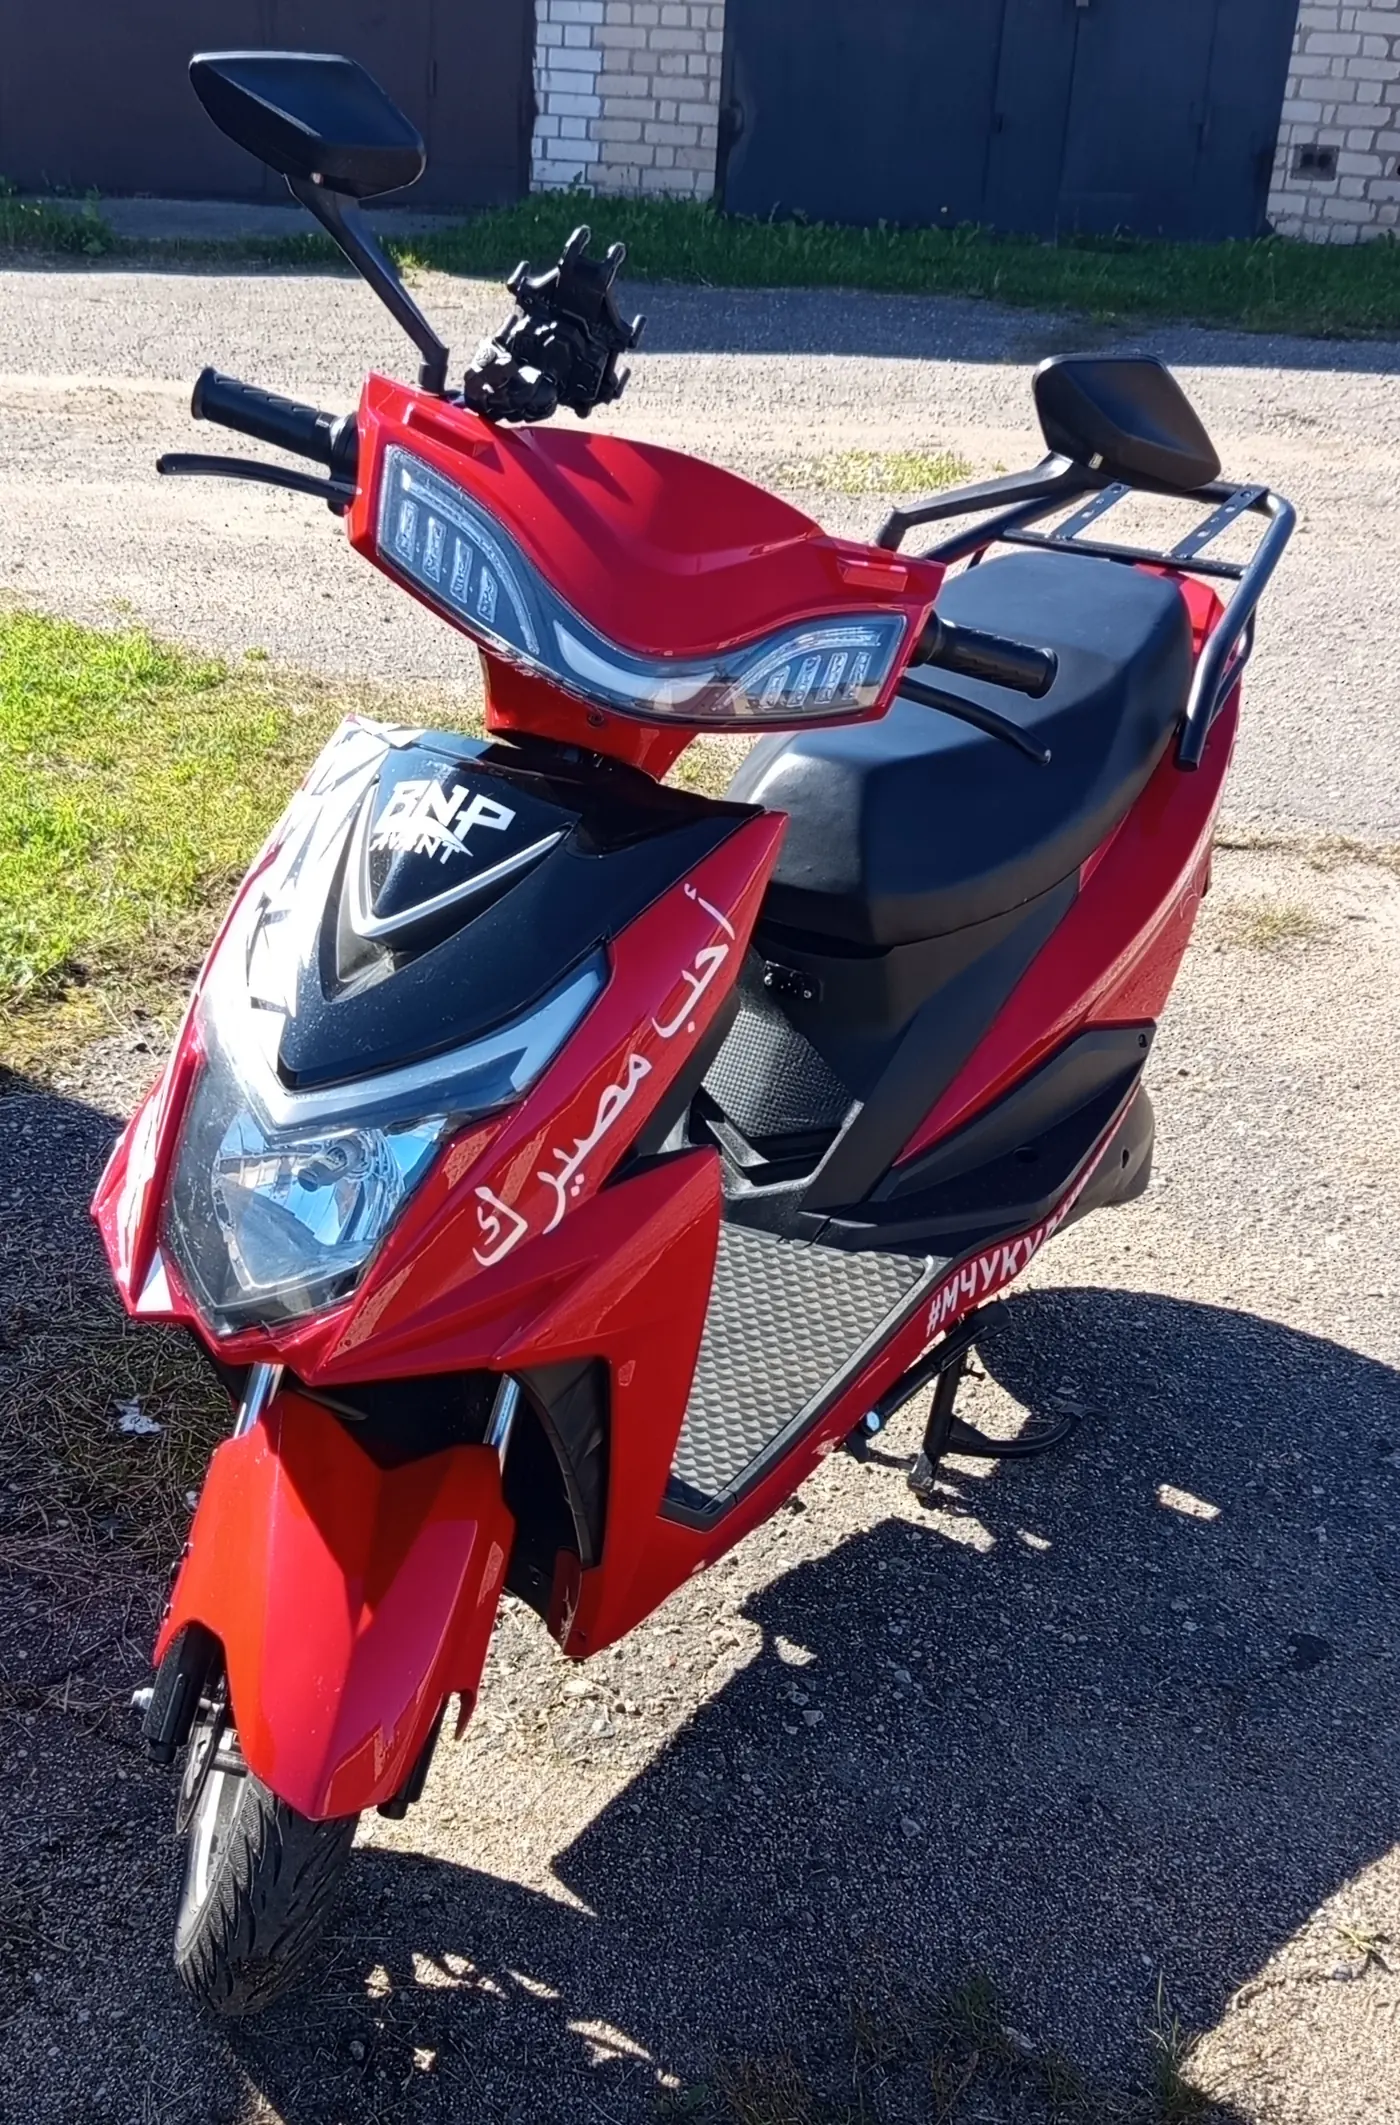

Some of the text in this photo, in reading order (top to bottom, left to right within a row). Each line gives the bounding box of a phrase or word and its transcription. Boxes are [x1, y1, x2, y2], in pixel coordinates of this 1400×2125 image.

[373, 779, 516, 842] BNP
[472, 882, 736, 1268] أحب مصيرك
[926, 1202, 1070, 1338] #МЧУКУ
